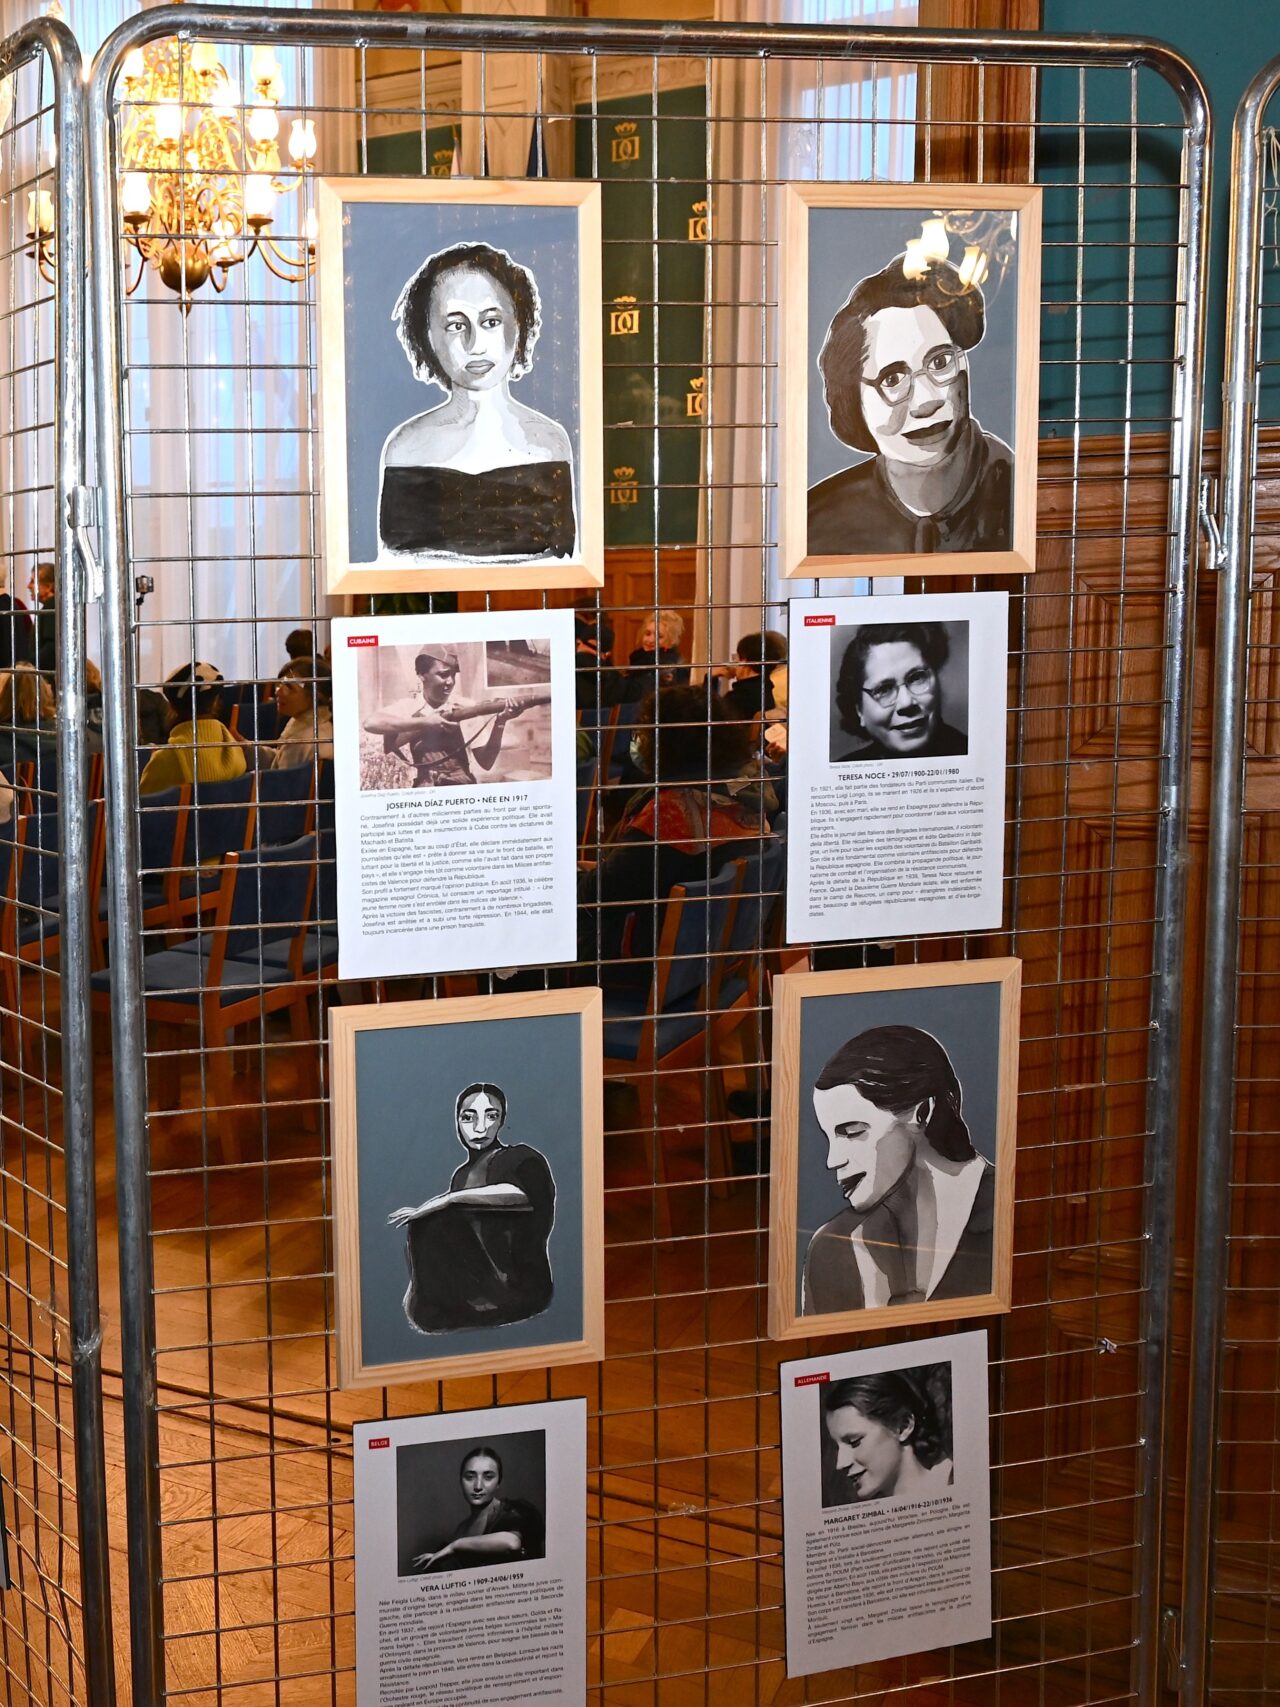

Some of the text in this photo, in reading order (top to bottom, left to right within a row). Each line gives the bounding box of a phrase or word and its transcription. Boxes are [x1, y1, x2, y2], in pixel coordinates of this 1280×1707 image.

[838, 773, 863, 781] TERESA
[865, 772, 886, 780] NOCE
[387, 794, 528, 811] JOSEFINA DÍAZ PUERTO NÉE EN 1917
[797, 1374, 827, 1385] ALLEMANDE
[824, 1513, 860, 1526] MARGARET
[862, 1509, 885, 1519] ZIMBAL
[420, 1584, 440, 1592] VERA
[441, 1581, 466, 1590] LUFTIG
